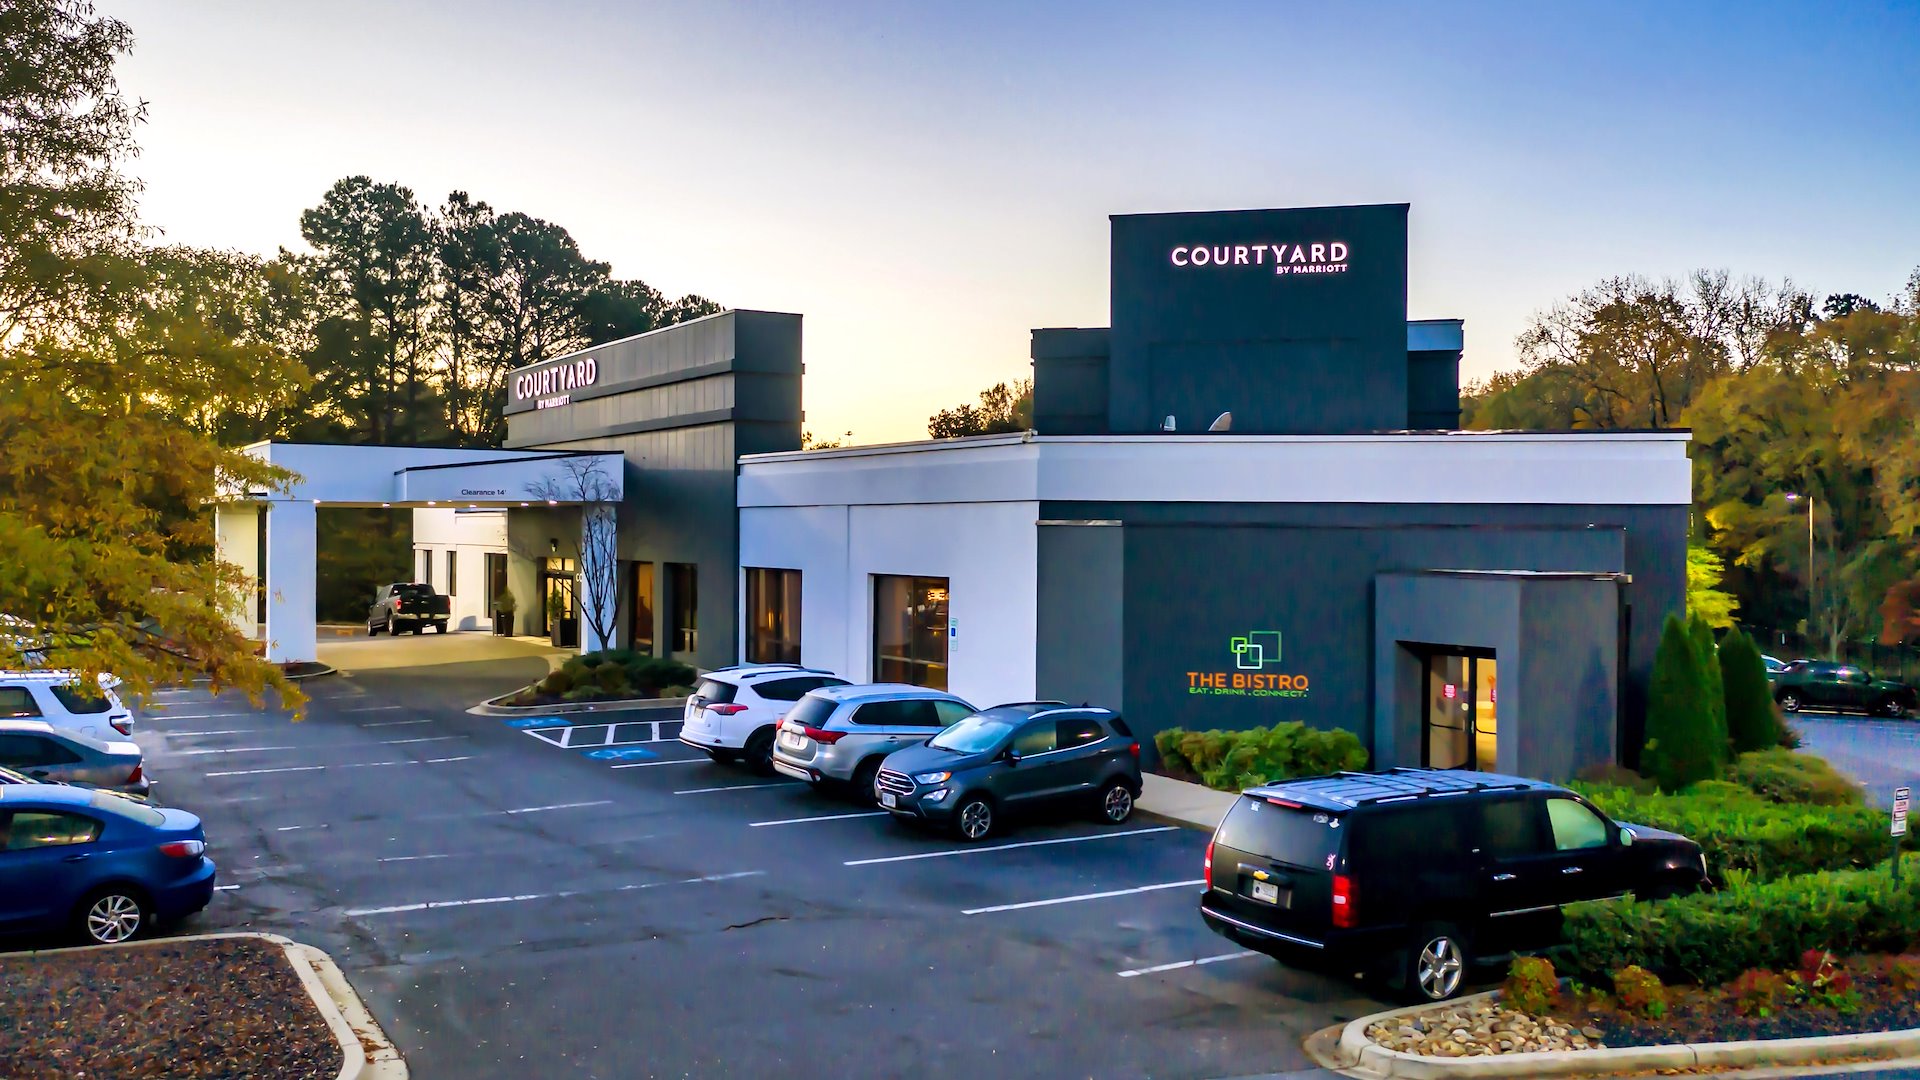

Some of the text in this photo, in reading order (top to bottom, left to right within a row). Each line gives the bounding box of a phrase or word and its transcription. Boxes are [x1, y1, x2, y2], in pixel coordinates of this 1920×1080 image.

[1171, 243, 1348, 266] COURTYARD
[1276, 264, 1347, 274] BY MARRIOTT
[516, 358, 596, 400] COURTYARD
[537, 394, 570, 409] BY MARRIOTT
[461, 488, 496, 496] Clearance
[1187, 672, 1227, 688] THE
